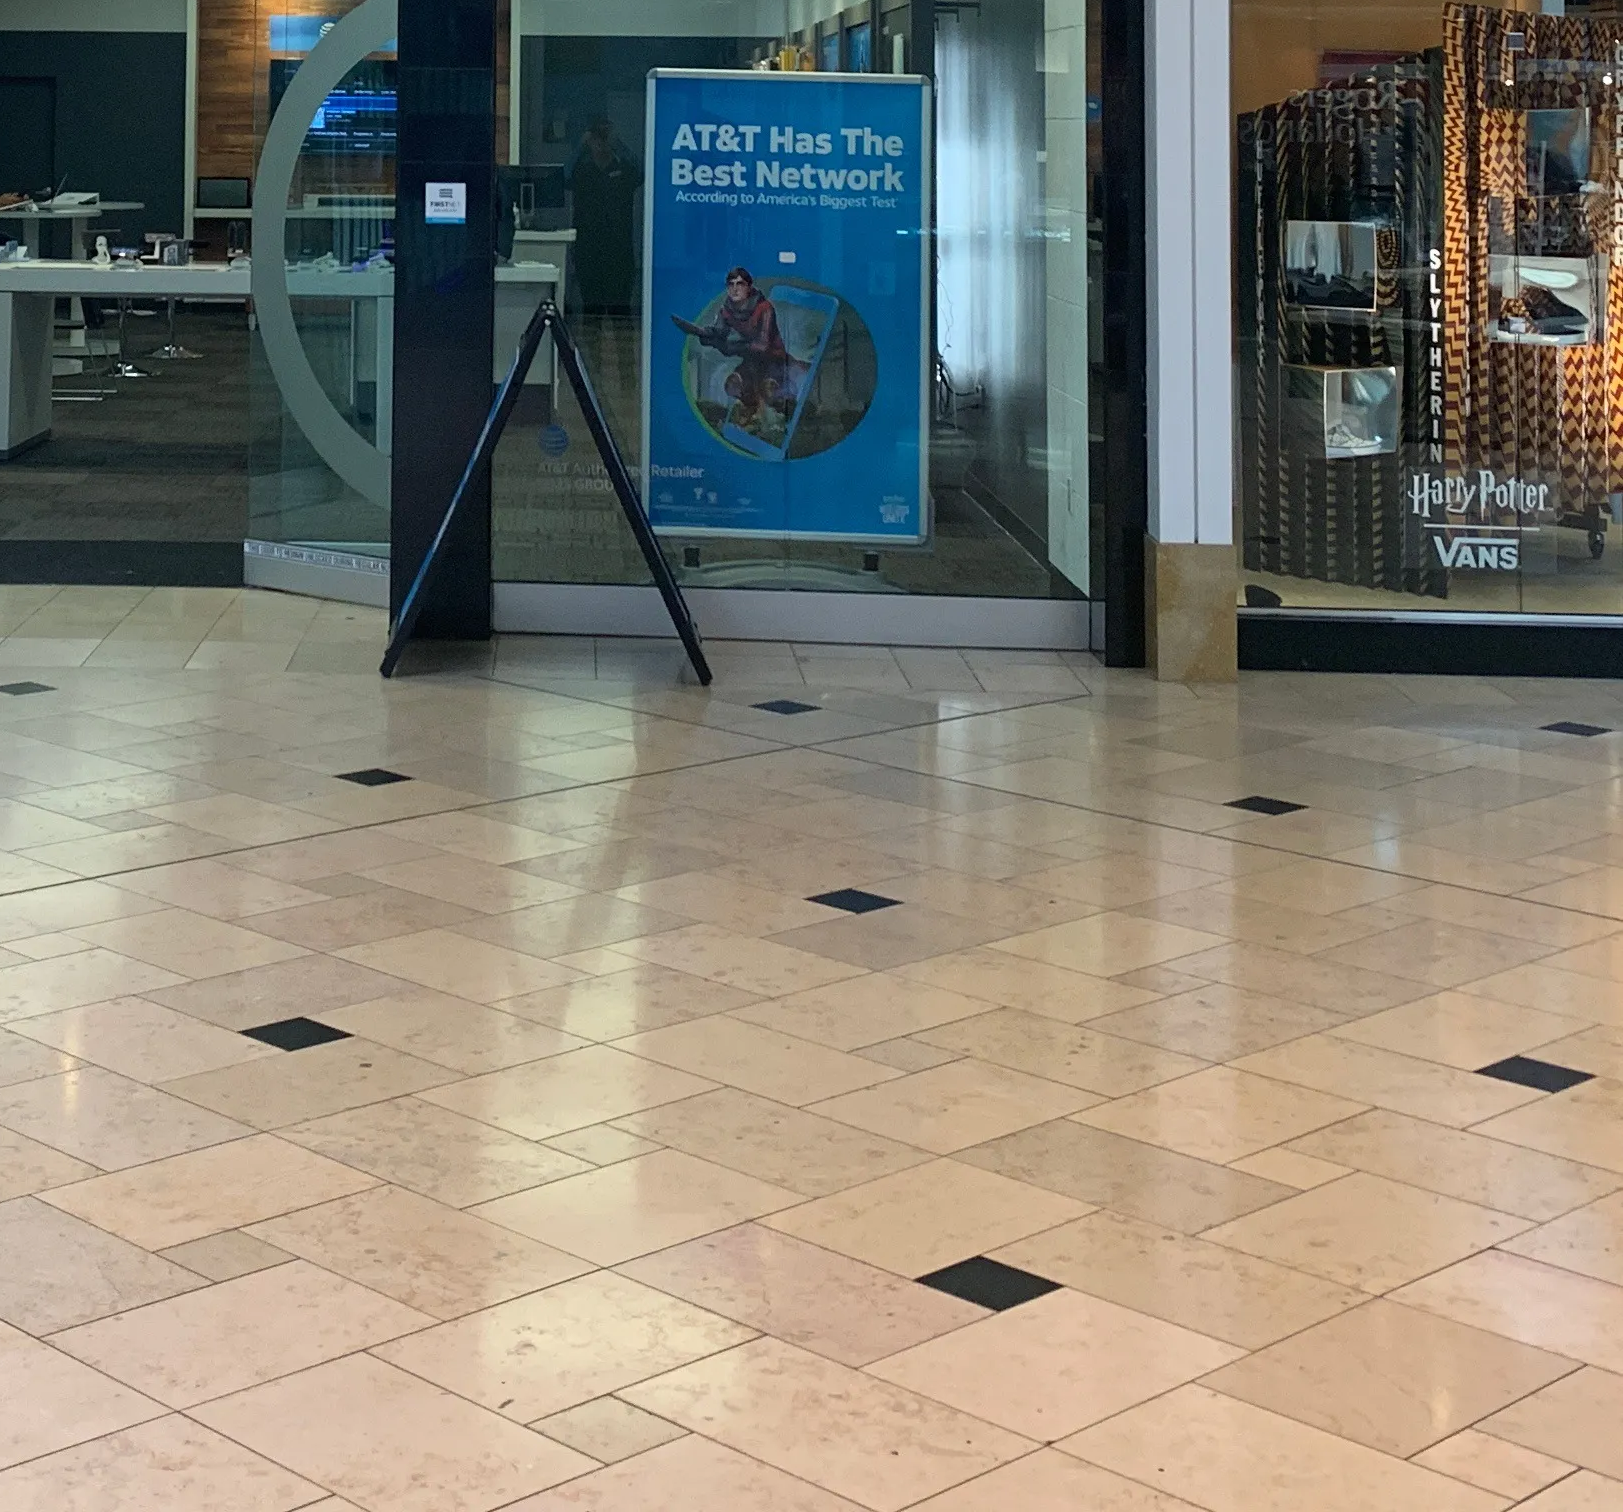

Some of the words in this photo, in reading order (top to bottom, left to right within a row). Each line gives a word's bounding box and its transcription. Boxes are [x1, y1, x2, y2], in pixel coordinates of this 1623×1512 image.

[671, 123, 762, 153] AT&T
[770, 125, 833, 154] Has
[840, 126, 905, 157] The
[671, 157, 748, 188] Best
[755, 159, 905, 192] Network
[675, 190, 738, 207] According
[740, 193, 755, 204] to
[757, 192, 817, 206] America's
[819, 193, 867, 210] Biggest
[1430, 248, 1443, 464] SLYTHERIN
[651, 463, 705, 479] Retailer
[1407, 472, 1477, 518] Harry
[1477, 469, 1549, 522] Potter
[1433, 535, 1520, 570] VANS
